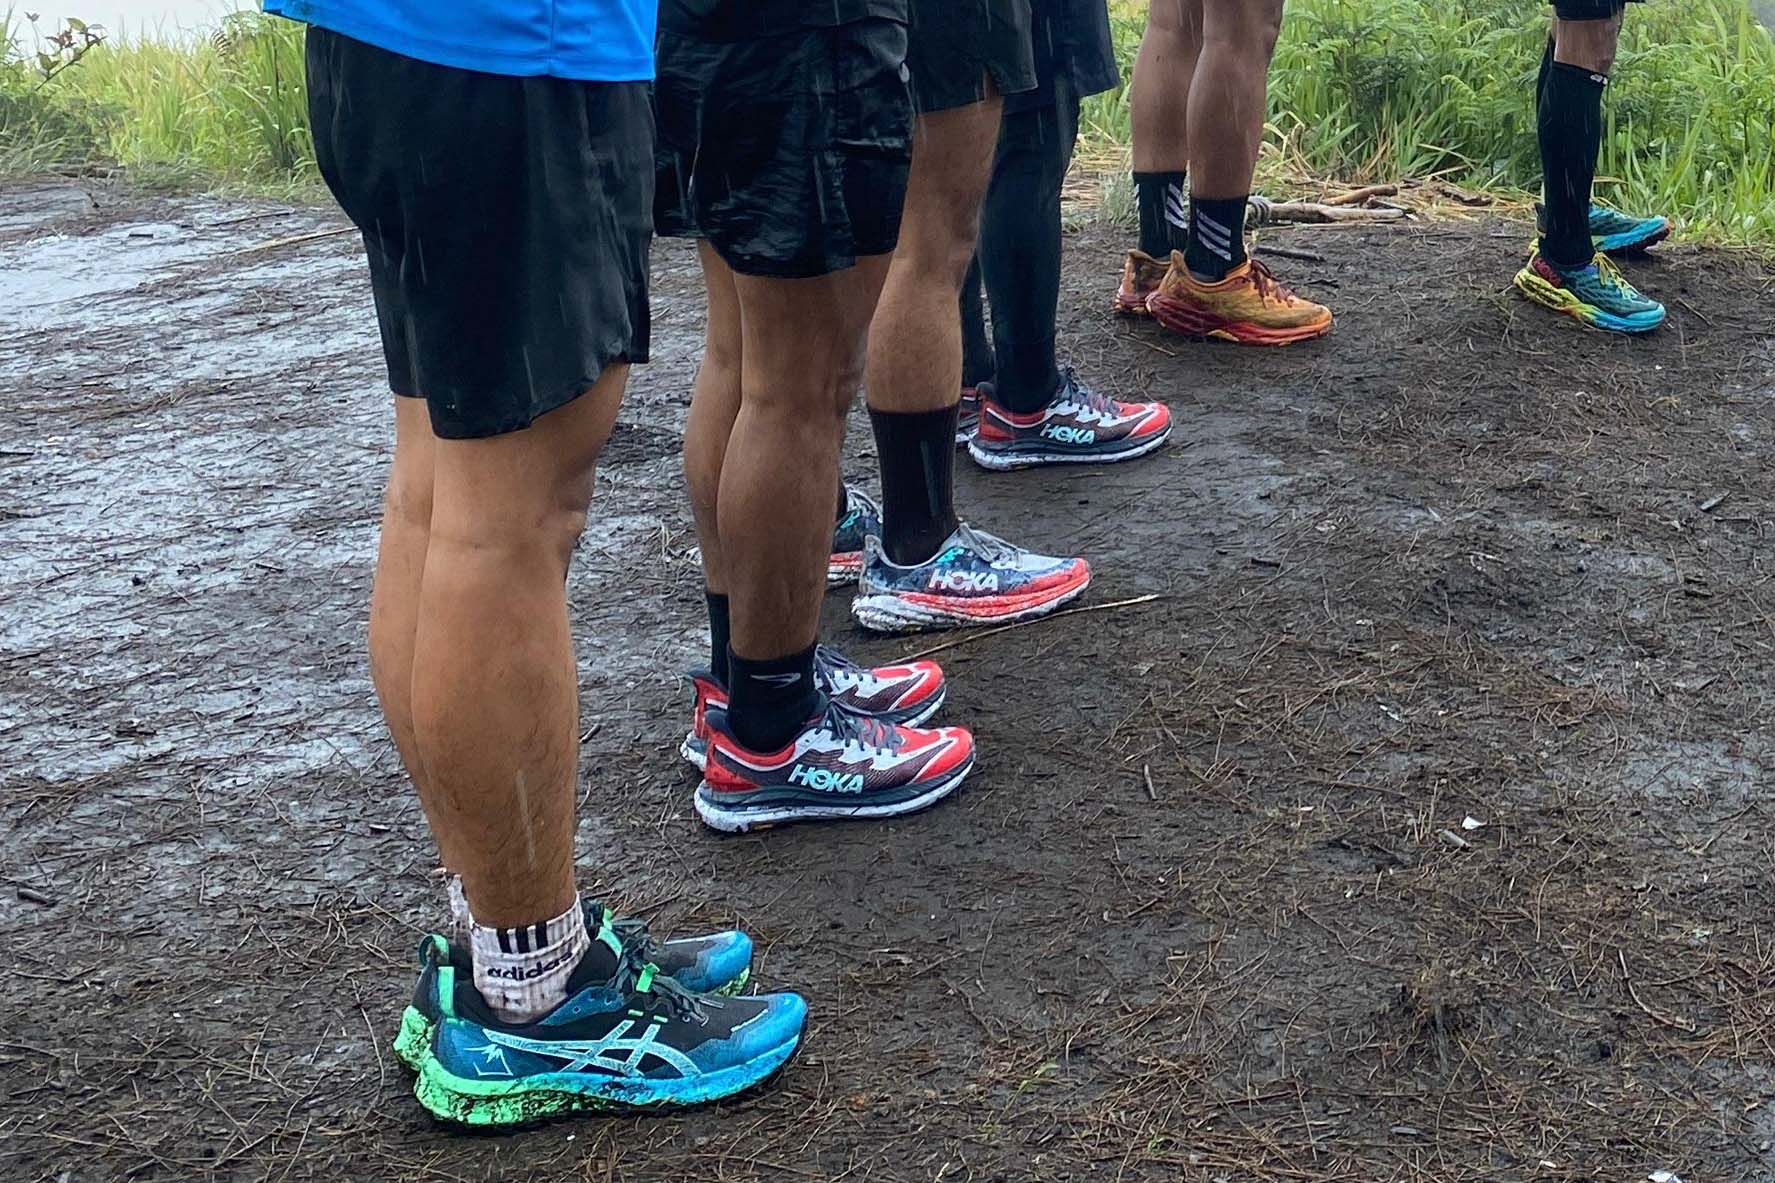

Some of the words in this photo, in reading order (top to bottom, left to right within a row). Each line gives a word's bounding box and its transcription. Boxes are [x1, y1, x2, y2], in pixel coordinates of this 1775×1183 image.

[1039, 422, 1095, 446] HOKA
[928, 568, 999, 592] HOKA
[787, 763, 865, 794] HOKA
